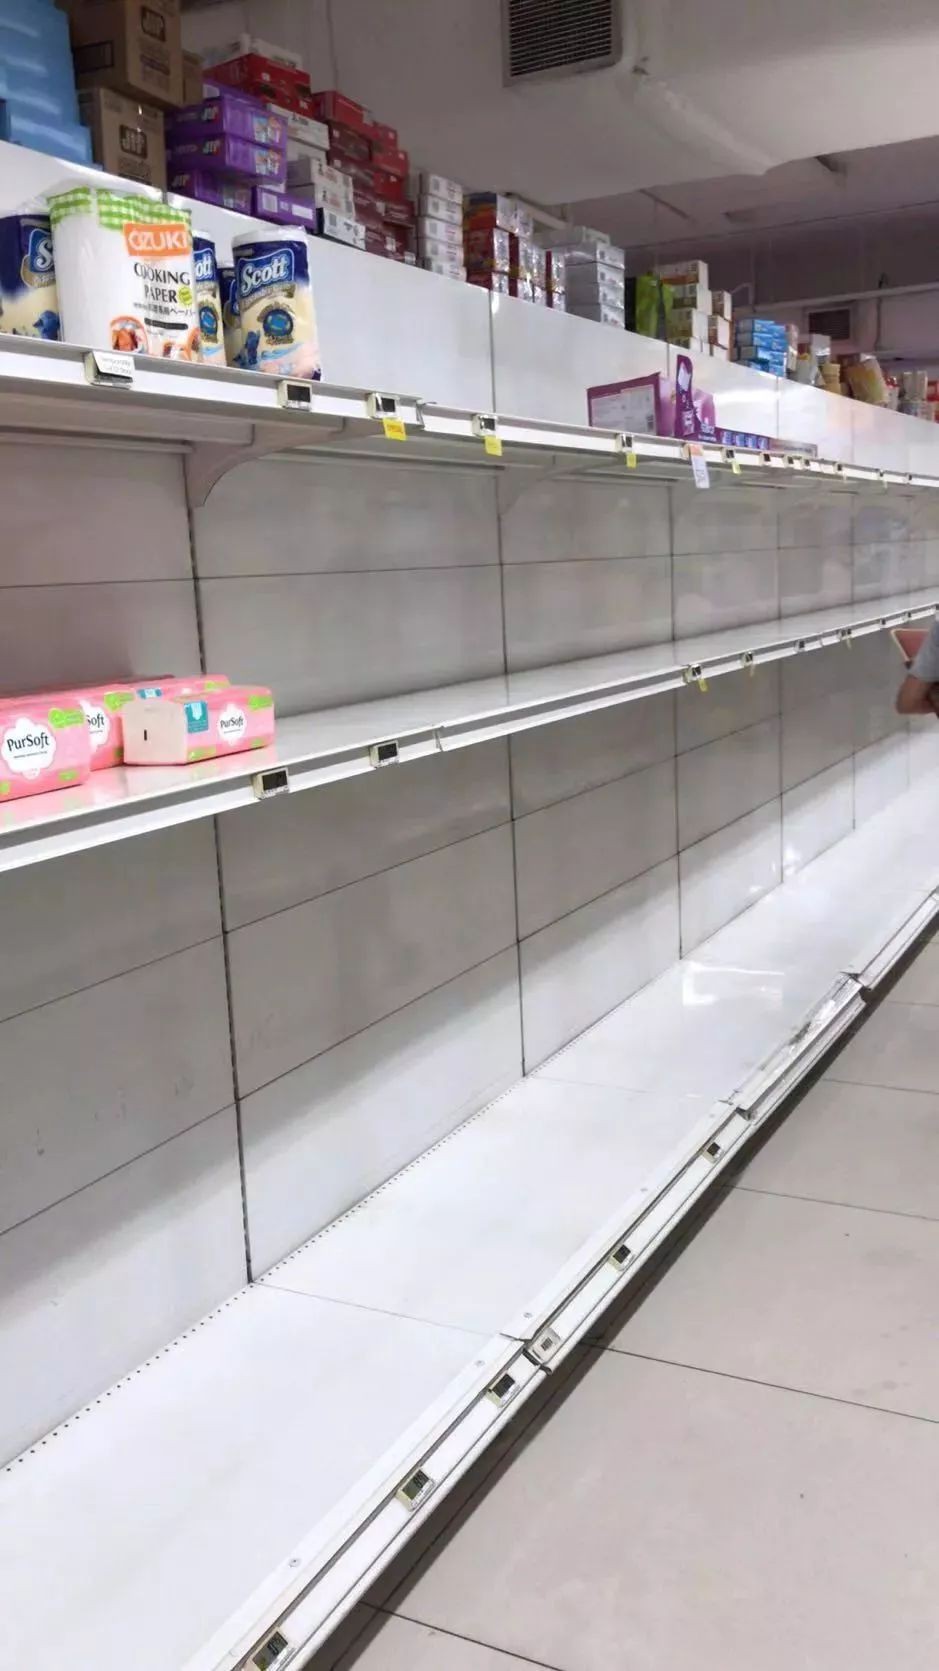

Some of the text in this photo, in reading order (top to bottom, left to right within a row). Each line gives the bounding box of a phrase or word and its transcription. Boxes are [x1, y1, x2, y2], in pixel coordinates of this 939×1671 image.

[121, 129, 144, 155] JIF
[127, 229, 188, 251] OZUKI
[134, 262, 191, 286] COOKING
[195, 255, 212, 277] ott
[241, 255, 288, 294] Scott
[144, 284, 178, 304] PAPER
[87, 713, 105, 729] Soft
[220, 714, 244, 729] PurSoft
[6, 731, 50, 752] PurSoft
